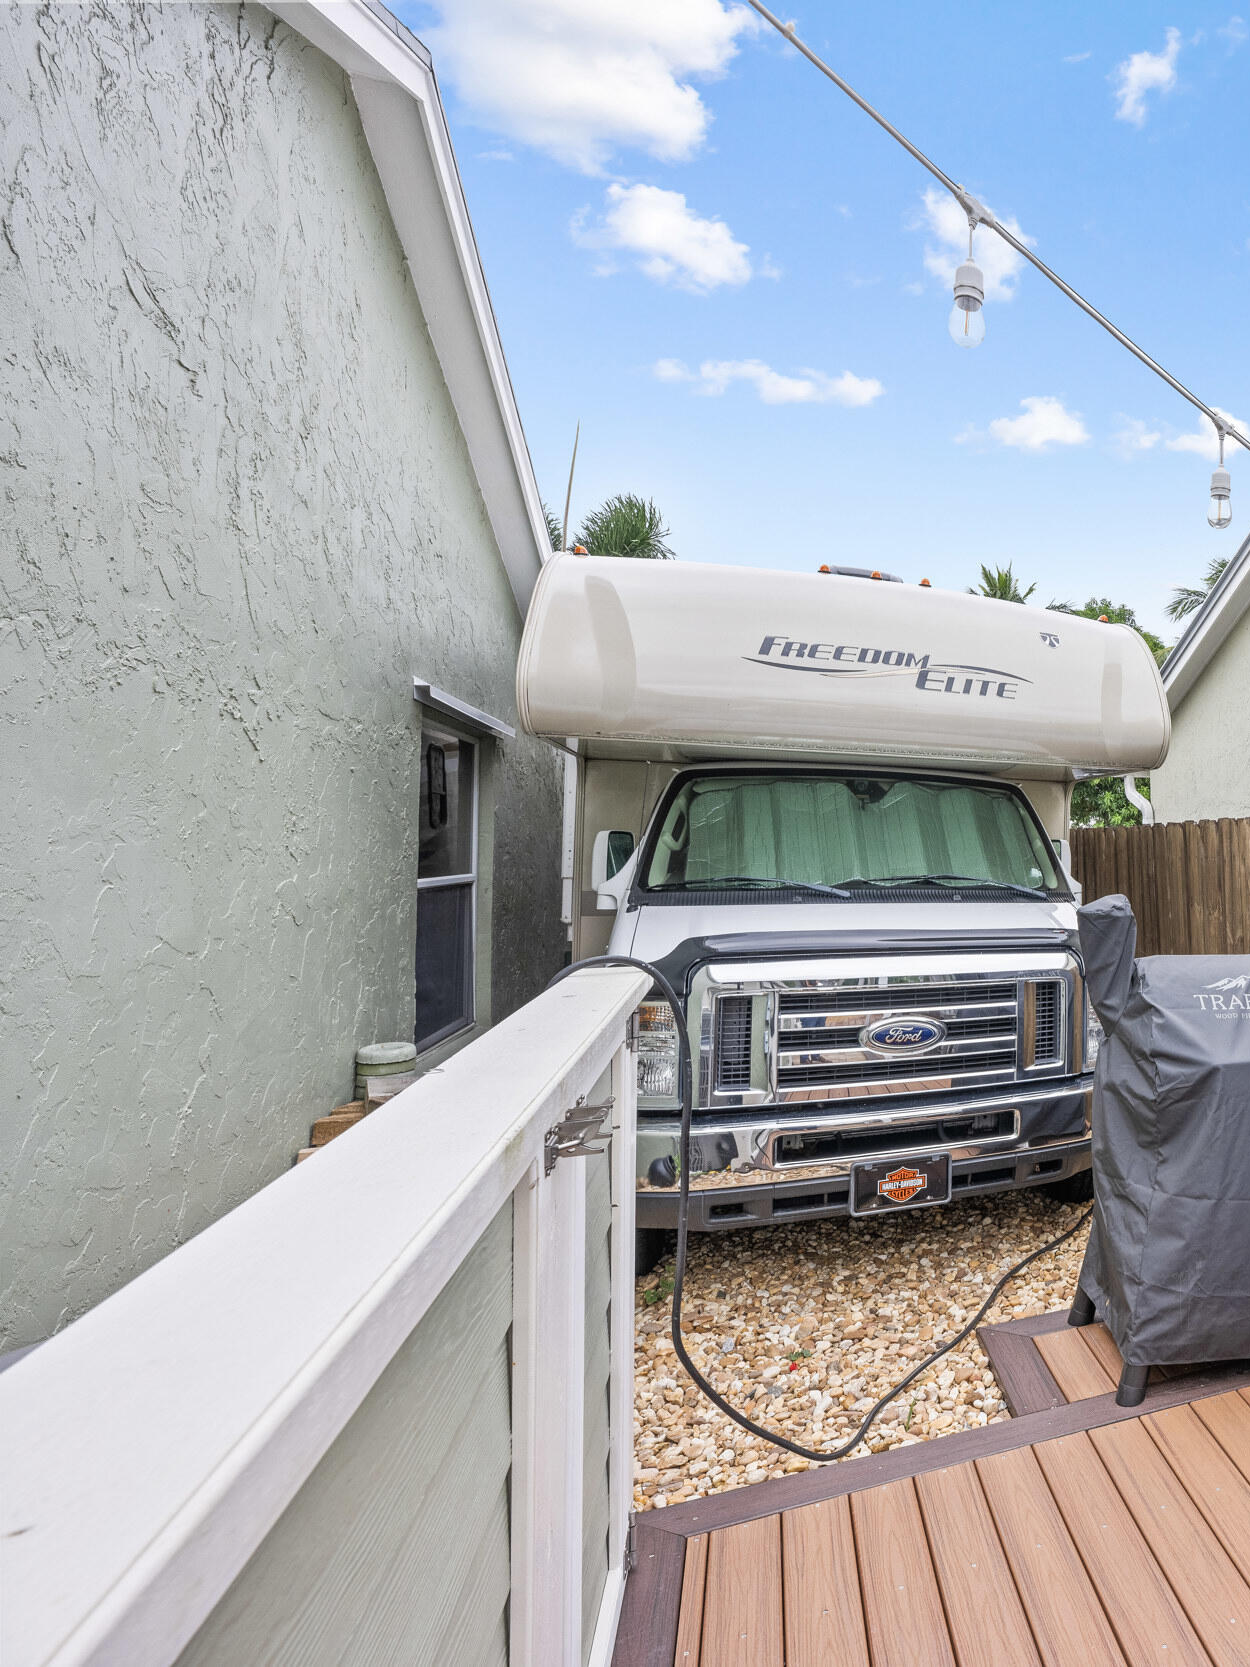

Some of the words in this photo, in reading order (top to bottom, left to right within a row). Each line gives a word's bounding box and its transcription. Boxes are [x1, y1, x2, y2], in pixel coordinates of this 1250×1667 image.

[758, 636, 930, 669] FREEDOM
[915, 669, 1018, 700] ELITE
[885, 1026, 922, 1044] Ford
